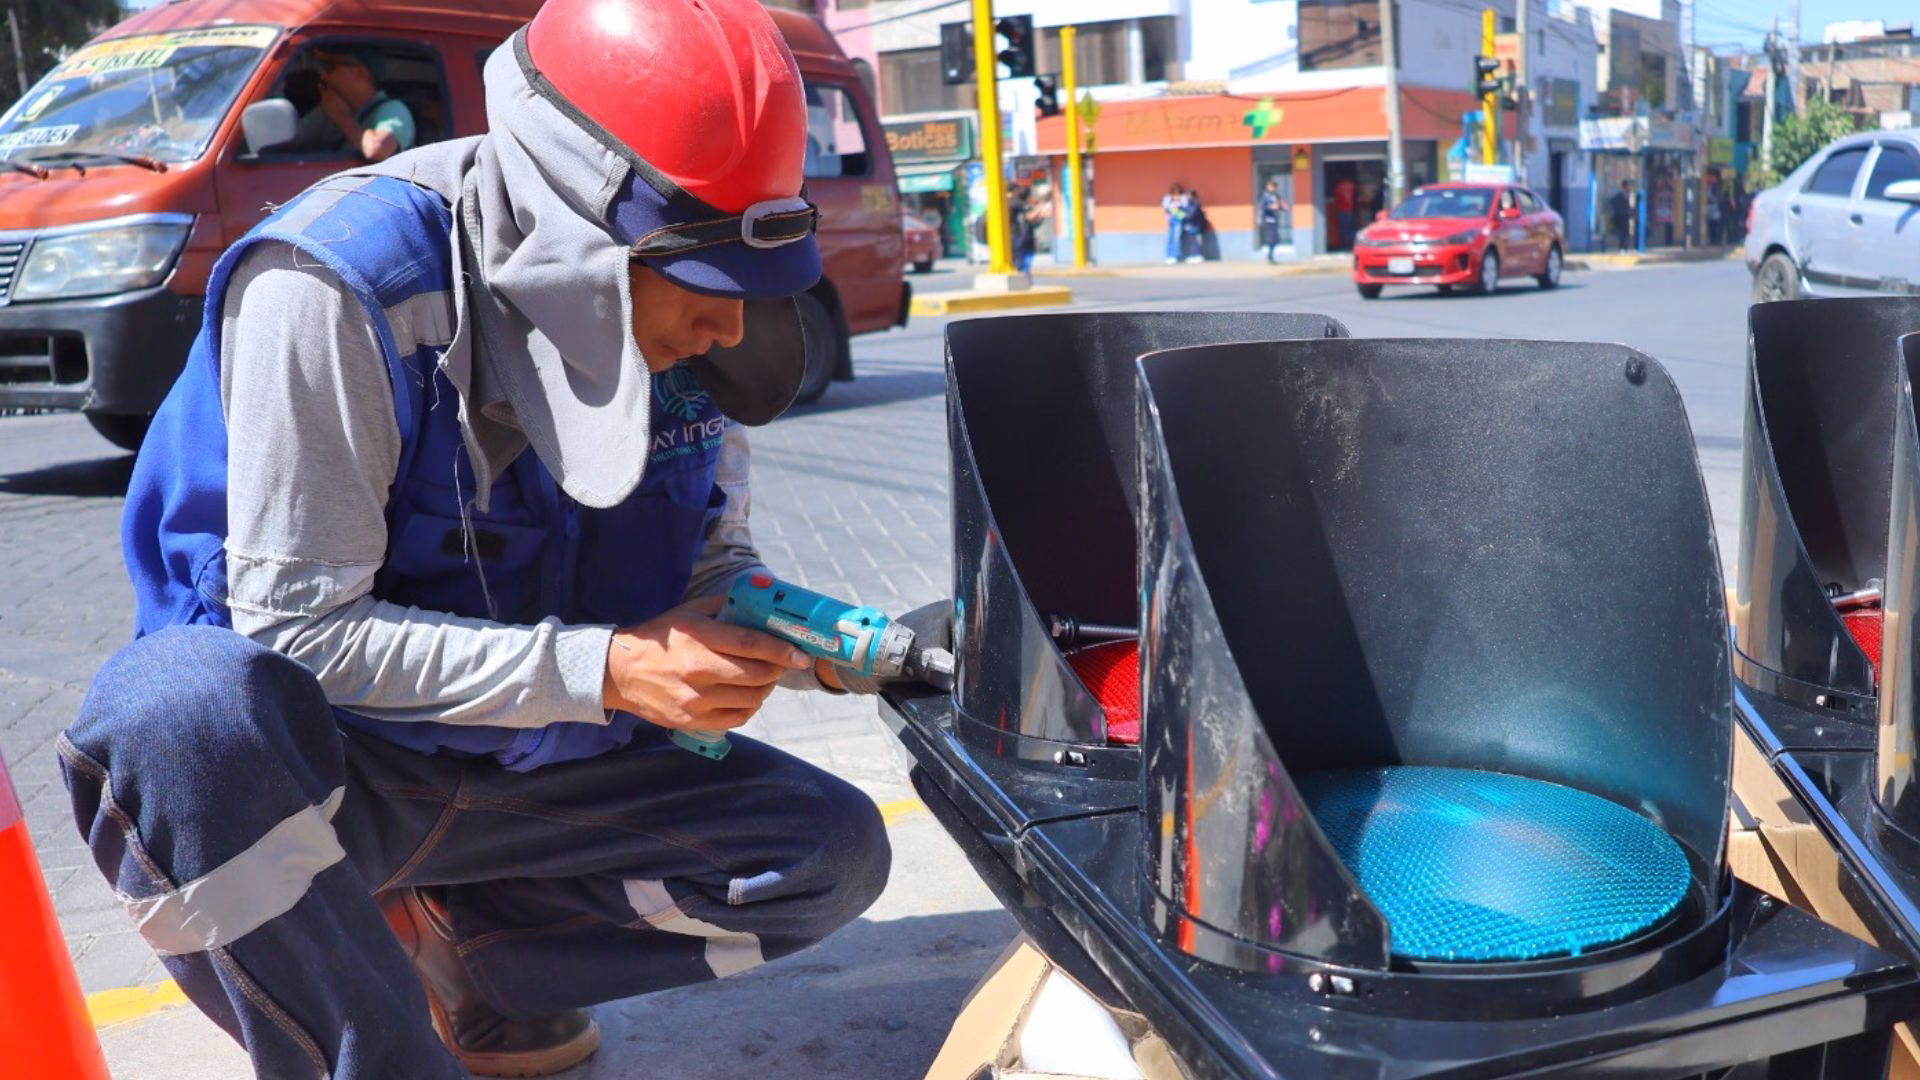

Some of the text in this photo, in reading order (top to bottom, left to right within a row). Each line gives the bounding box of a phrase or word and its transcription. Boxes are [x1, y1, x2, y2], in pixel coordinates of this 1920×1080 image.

[886, 130, 957, 151] Boticas
[651, 414, 725, 451] AY ING
